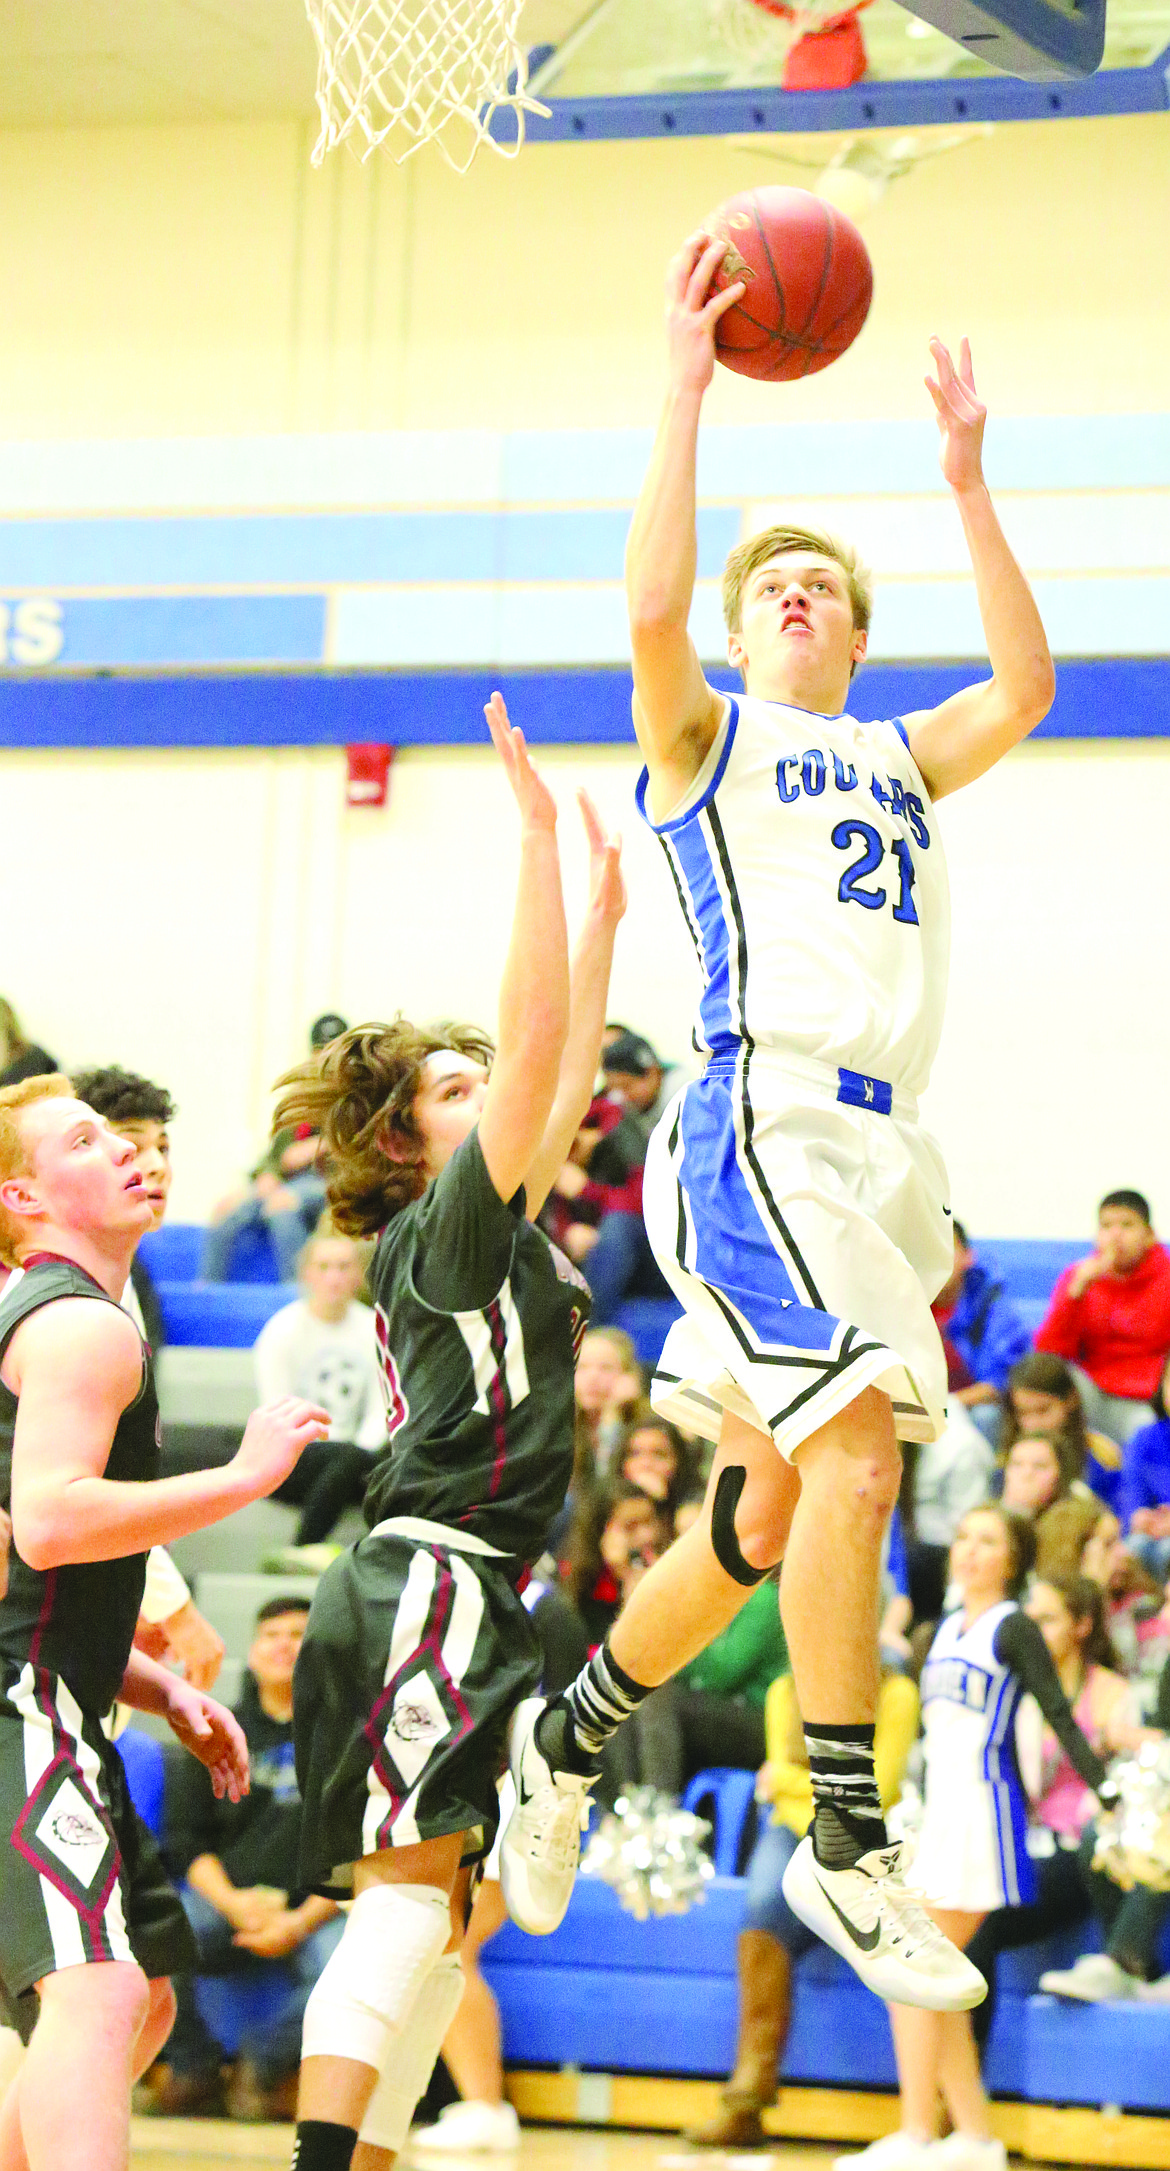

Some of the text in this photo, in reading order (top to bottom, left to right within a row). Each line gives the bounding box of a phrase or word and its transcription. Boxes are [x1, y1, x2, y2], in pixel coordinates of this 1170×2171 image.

[0, 598, 63, 664] S
[775, 747, 931, 850] COUARS
[830, 818, 920, 927] 21
